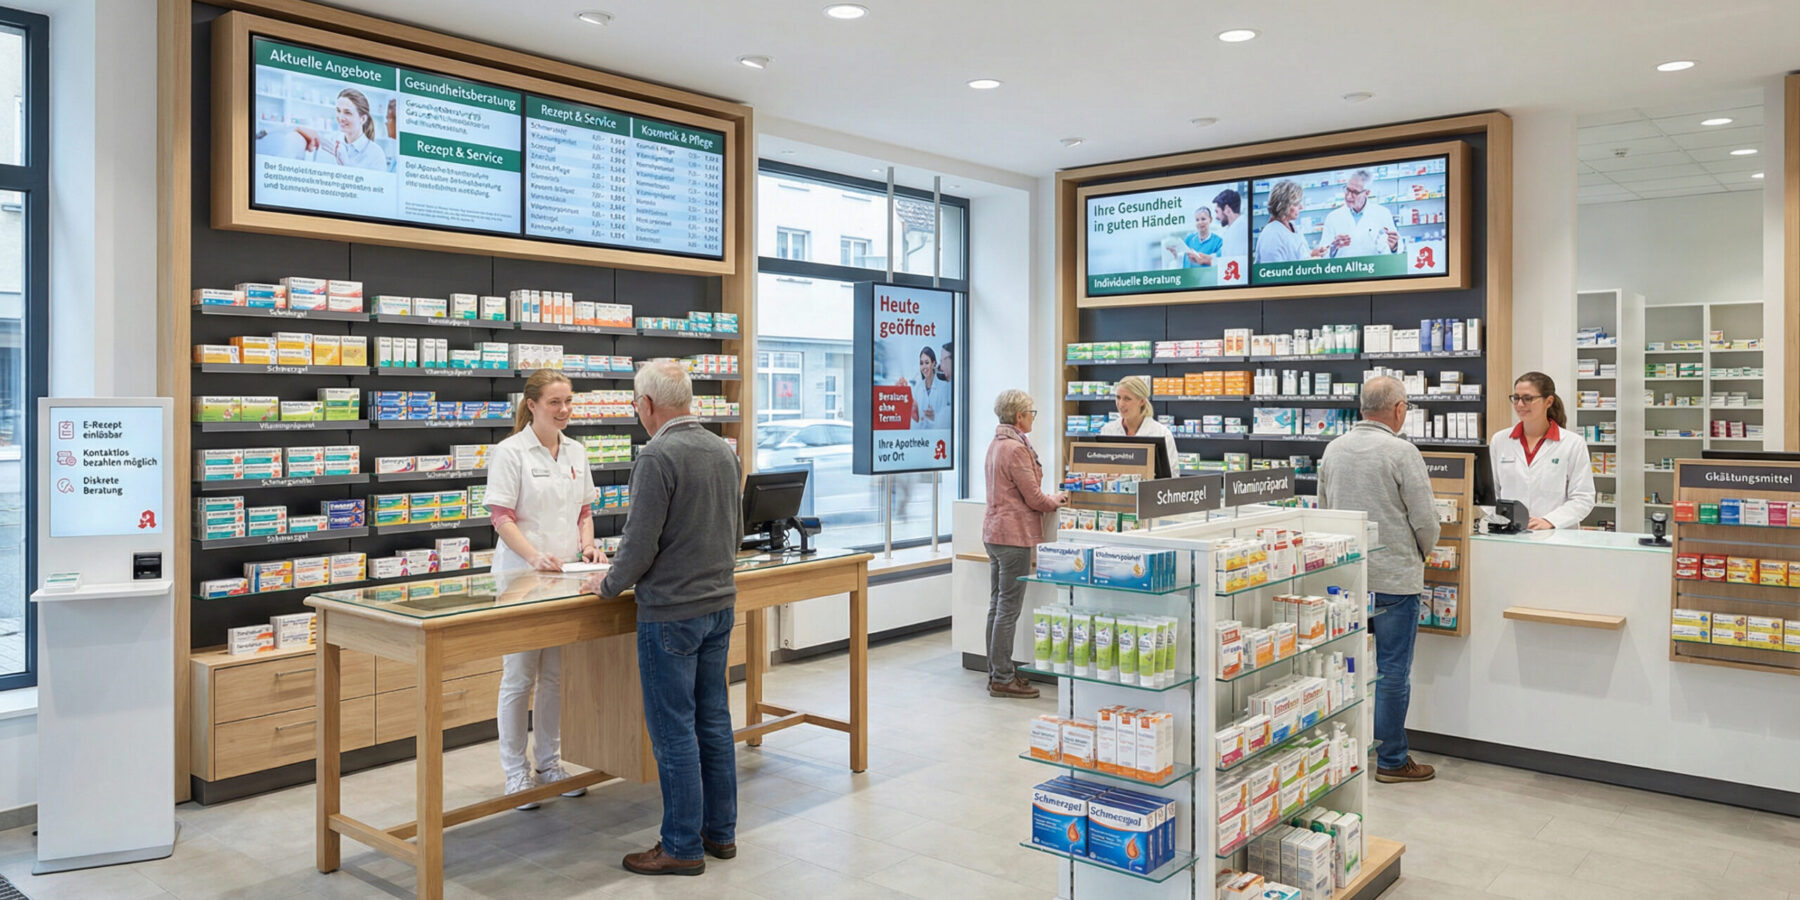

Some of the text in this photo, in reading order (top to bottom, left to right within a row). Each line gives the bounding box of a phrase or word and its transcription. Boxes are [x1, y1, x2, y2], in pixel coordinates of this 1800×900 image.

[270, 49, 382, 82] Aktuelle Angebote
[404, 76, 516, 111] Gesundheitsberatung
[541, 104, 617, 129] Rezept & Service
[681, 132, 688, 143] &
[689, 134, 713, 150] Pflege
[417, 140, 503, 164] Rezept & Service
[1094, 196, 1182, 217] Ihre Gesundheit
[1094, 214, 1186, 235] in guten Händen
[1259, 261, 1375, 278] Gesund durch den Alltag
[1094, 274, 1182, 288] Individuelle Beratung
[880, 295, 920, 314] Heute
[880, 318, 936, 338] geöffnet
[878, 392, 909, 403] Beratung
[878, 403, 896, 412] ohne
[879, 413, 902, 422] Termin
[83, 448, 130, 457] Kontaktlos
[878, 437, 930, 450] Ihre Apotheke
[83, 457, 158, 468] bezahlen möglich
[878, 451, 905, 462] vor Ort
[83, 476, 120, 485] Diskrete
[1232, 475, 1289, 495] Vitaminpräparat
[83, 486, 123, 496] Beratung
[1156, 485, 1207, 505] Schmerzgel
[1034, 792, 1082, 812] Schmerzgel
